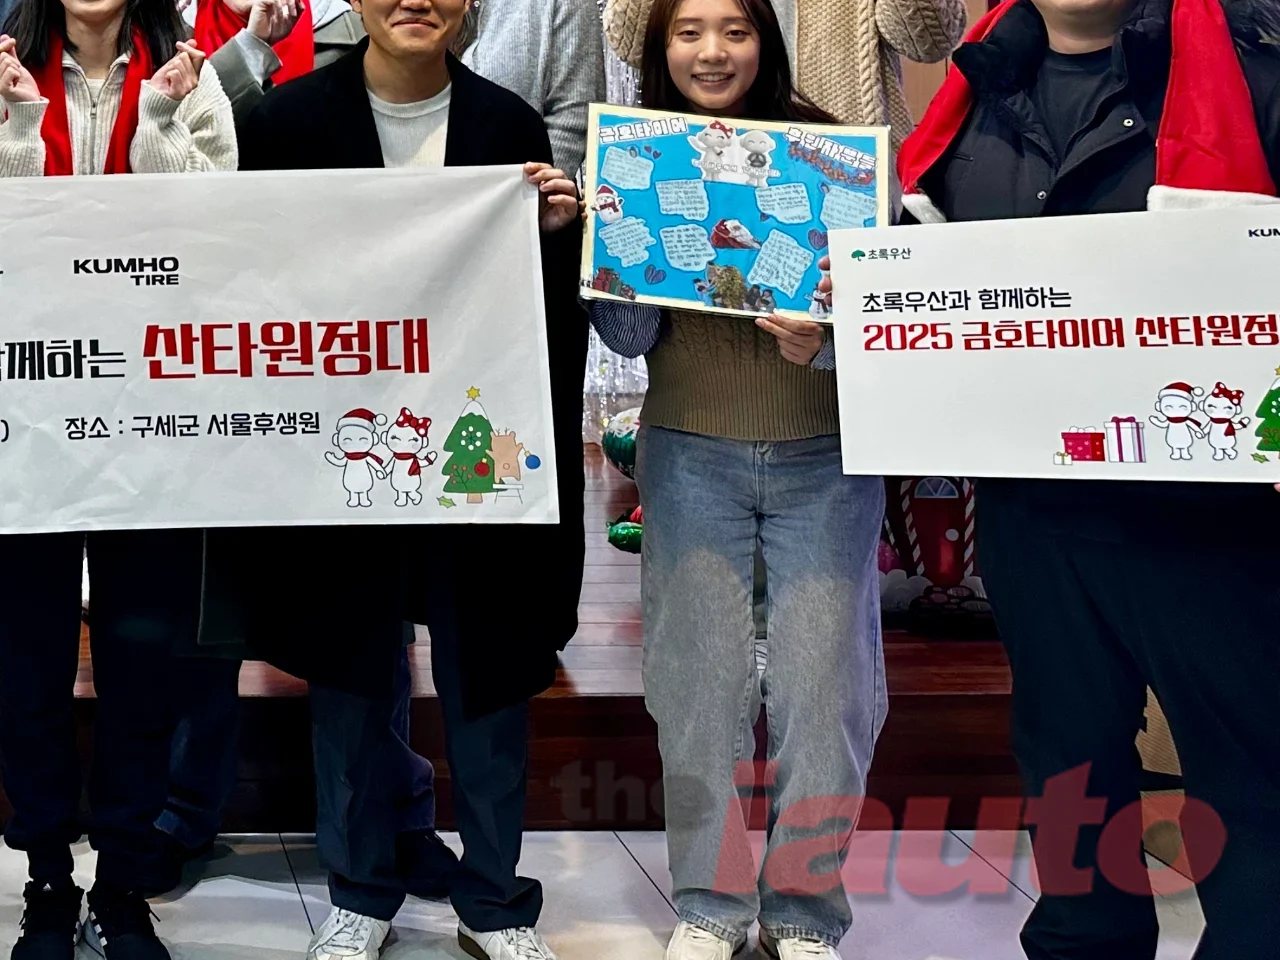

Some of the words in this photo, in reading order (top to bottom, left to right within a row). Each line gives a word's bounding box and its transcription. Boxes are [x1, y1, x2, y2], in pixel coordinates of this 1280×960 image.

[599, 116, 688, 144] 금호타이어
[73, 256, 179, 274] KUMHO
[868, 247, 912, 260] 초록우산
[130, 274, 179, 286] TIRE
[862, 289, 971, 313] 초록우산과
[978, 287, 1072, 310] 함께하는
[863, 322, 954, 351] 2025
[961, 317, 1125, 351] 금호타이어
[143, 317, 431, 379] 산타원정대
[64, 415, 111, 440] 장소
[131, 414, 200, 439] 구세군
[207, 411, 321, 437] 서울후생원
